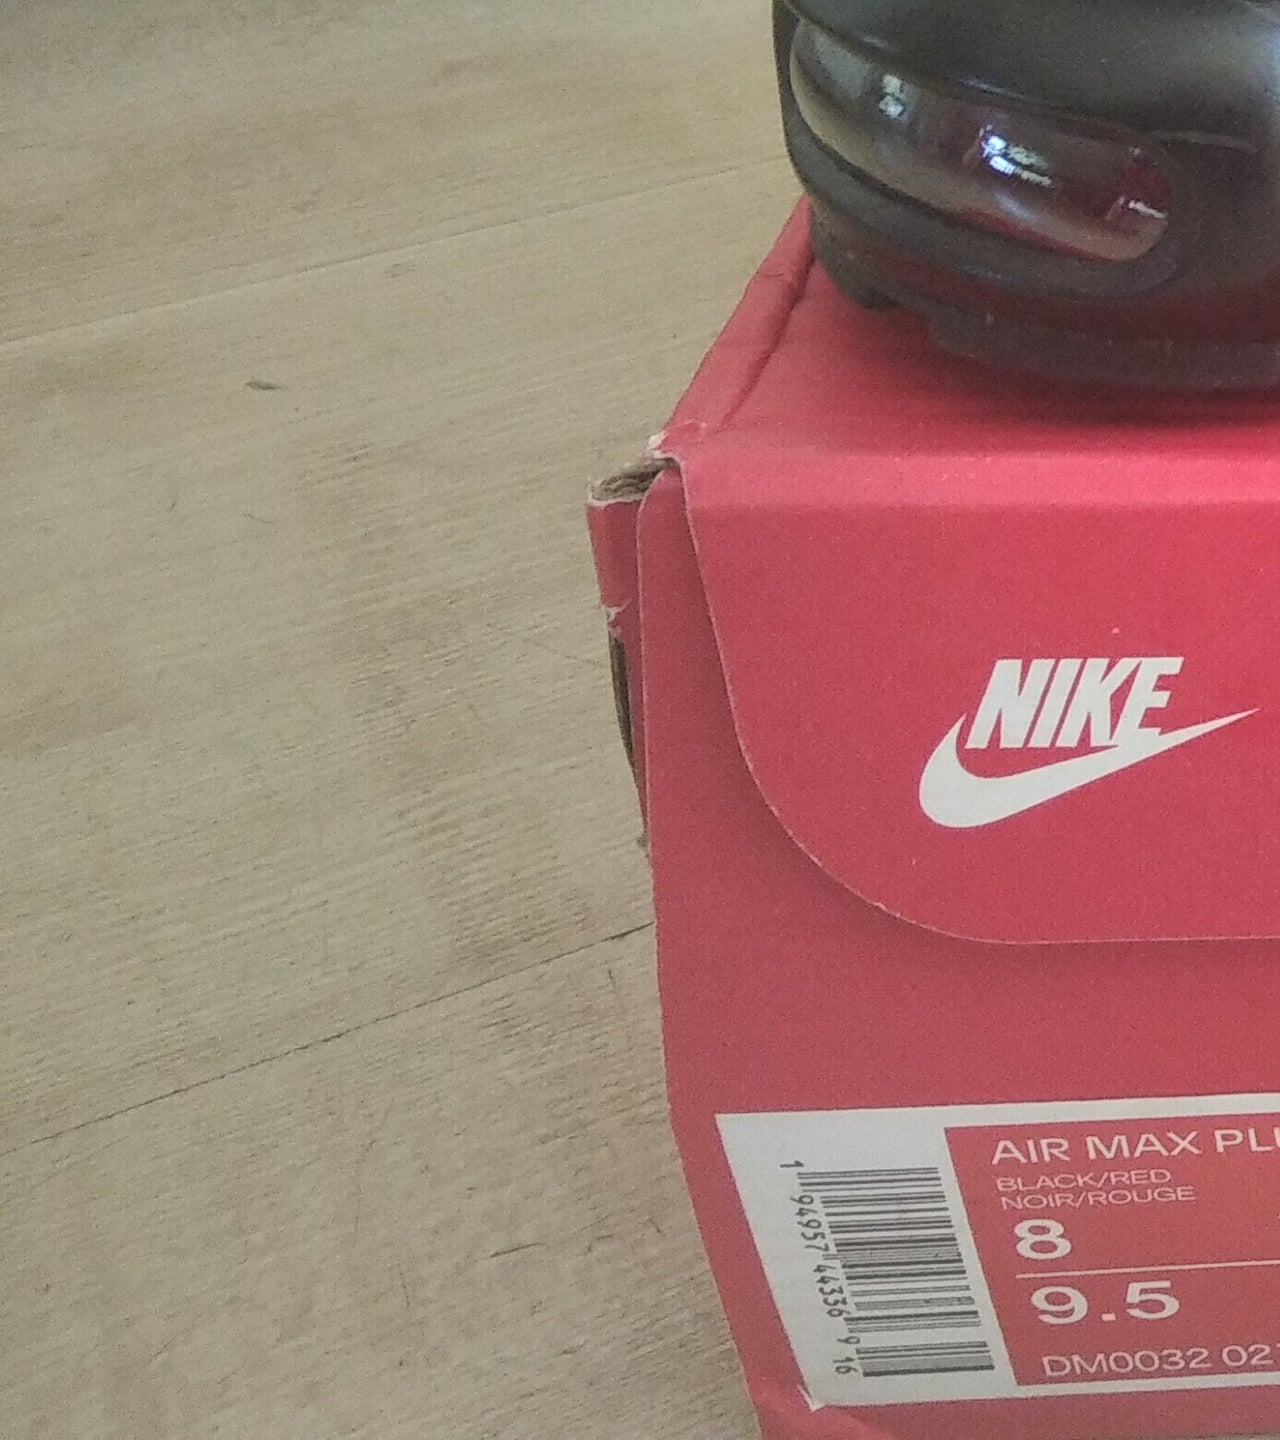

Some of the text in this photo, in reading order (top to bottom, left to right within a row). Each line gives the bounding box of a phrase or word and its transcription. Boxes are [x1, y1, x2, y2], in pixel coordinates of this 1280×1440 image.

[965, 656, 1184, 749] NIKE
[991, 1136, 1071, 1166] AIR
[1085, 1130, 1202, 1160] MAX
[995, 1168, 1172, 1193] BLACK/RED
[1000, 1185, 1196, 1211] NOIR/ROUGE
[1013, 1217, 1073, 1261] 8
[1030, 1279, 1181, 1325] 9.5
[1041, 1347, 1211, 1378] DM0032
